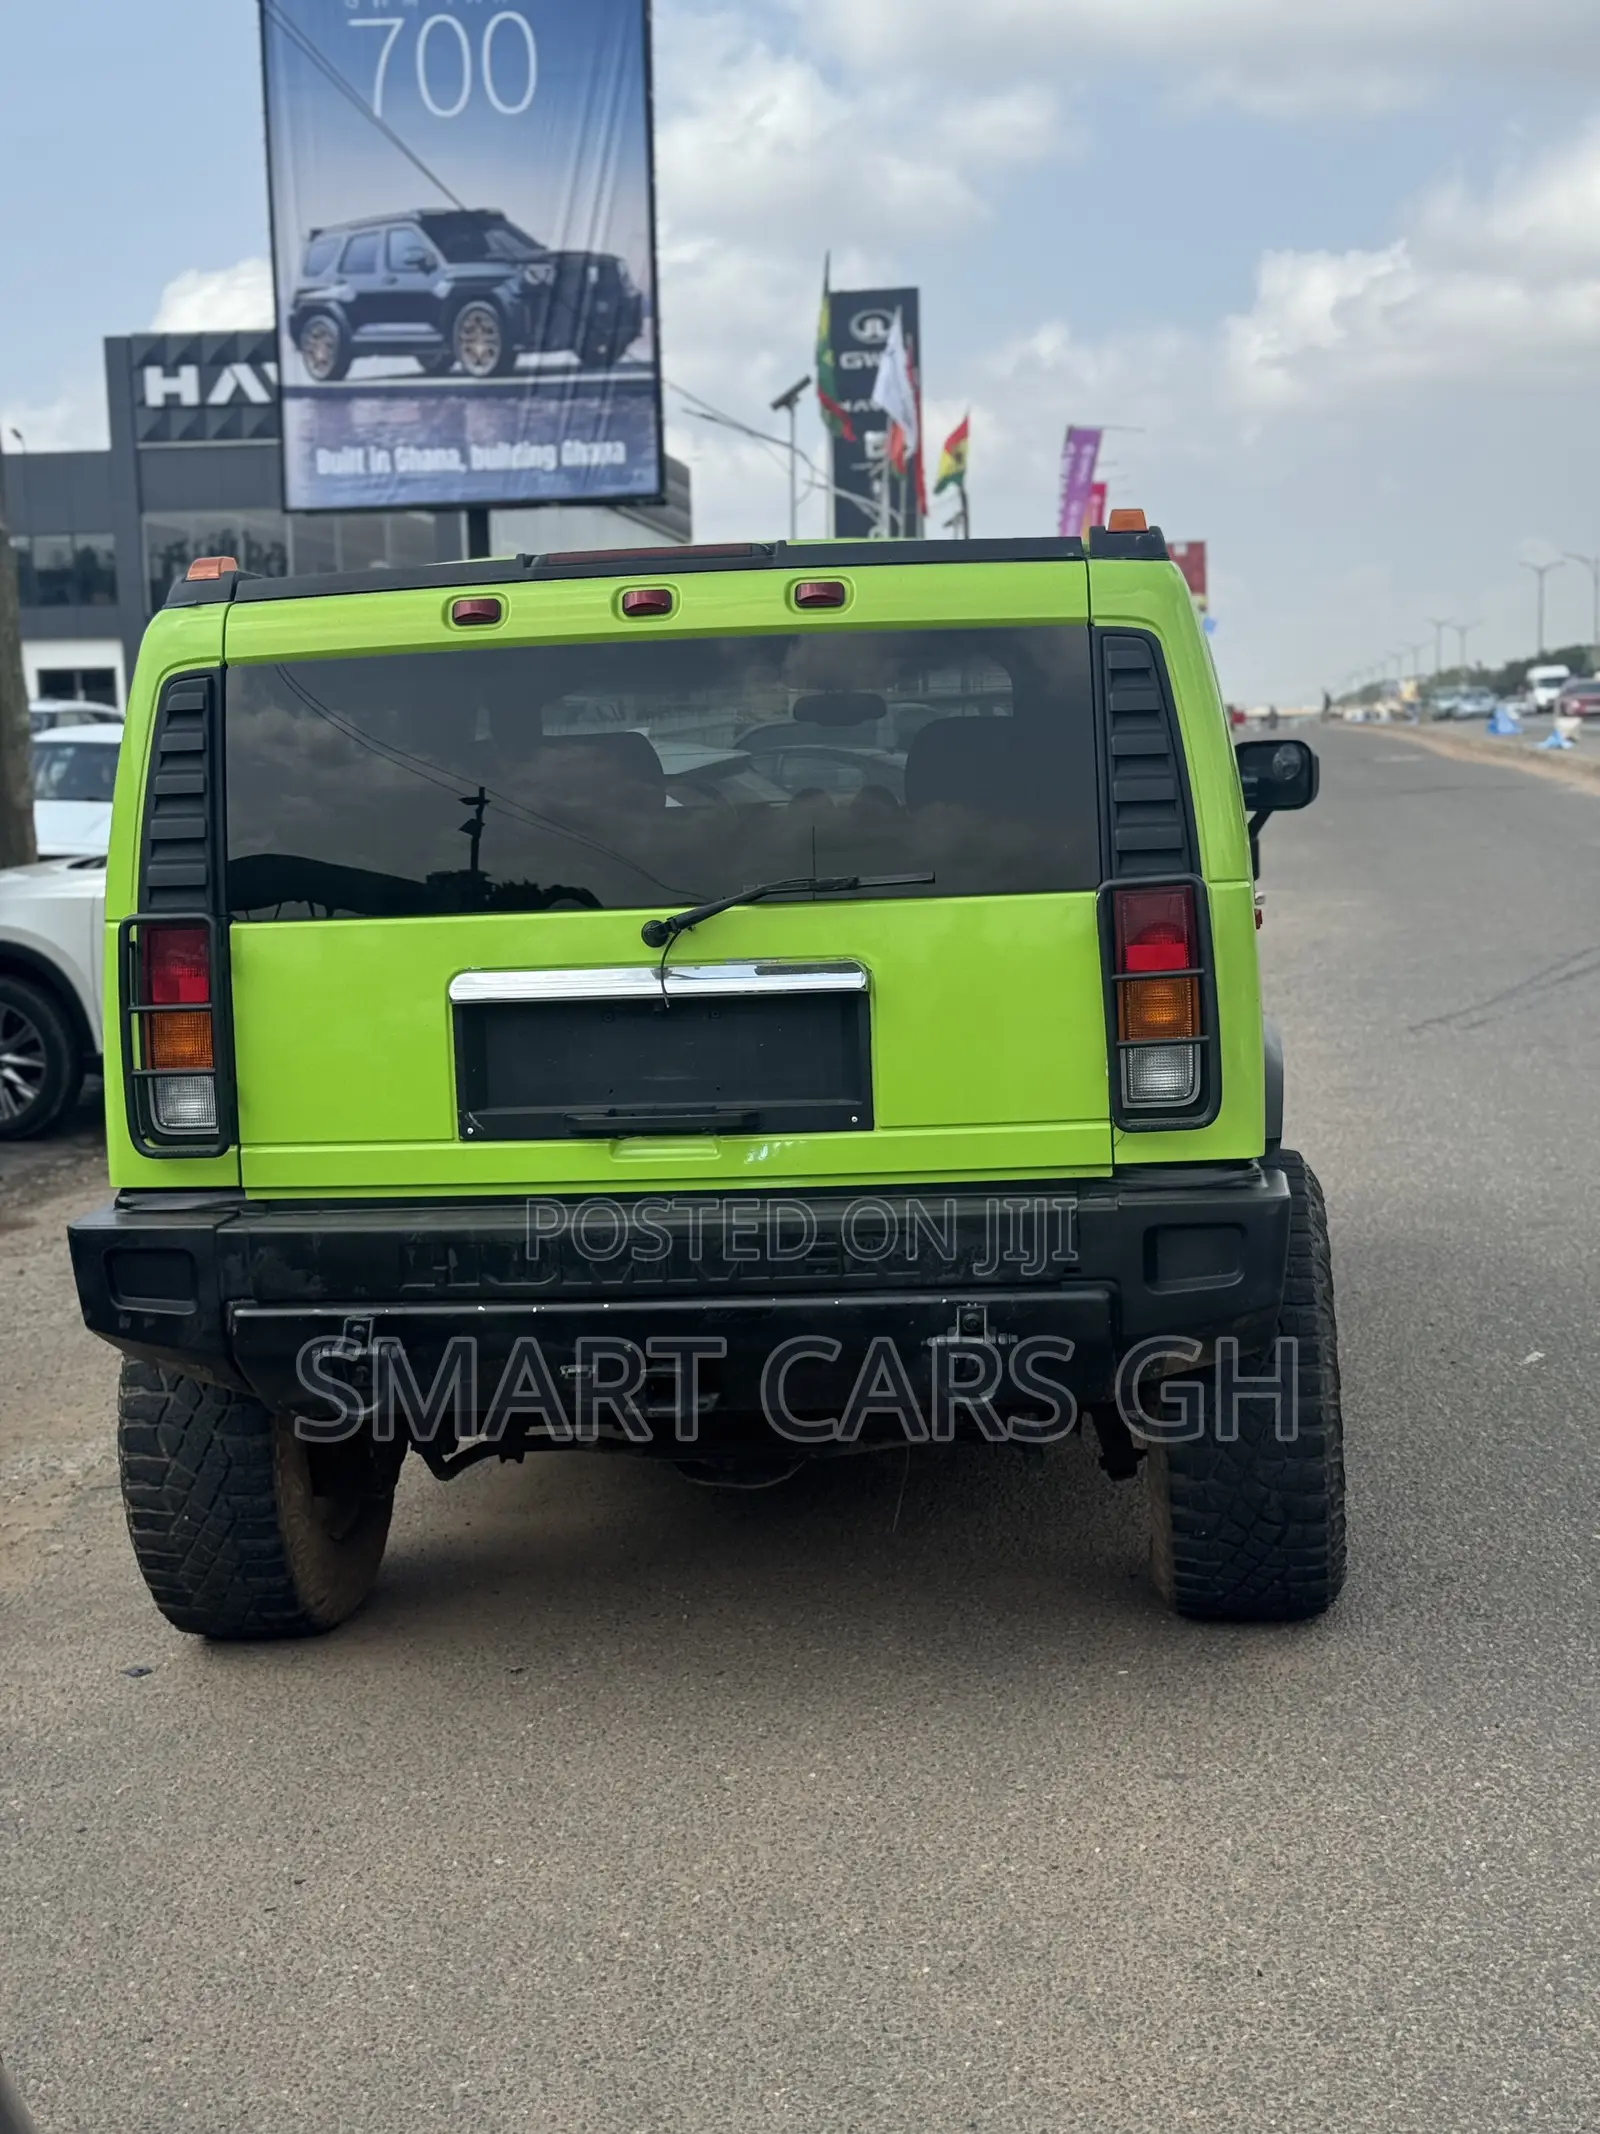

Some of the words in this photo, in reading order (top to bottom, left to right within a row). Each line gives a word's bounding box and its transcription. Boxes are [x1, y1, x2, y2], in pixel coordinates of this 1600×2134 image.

[348, 11, 537, 118] 700
[143, 362, 278, 407] HA
[368, 445, 391, 474] in
